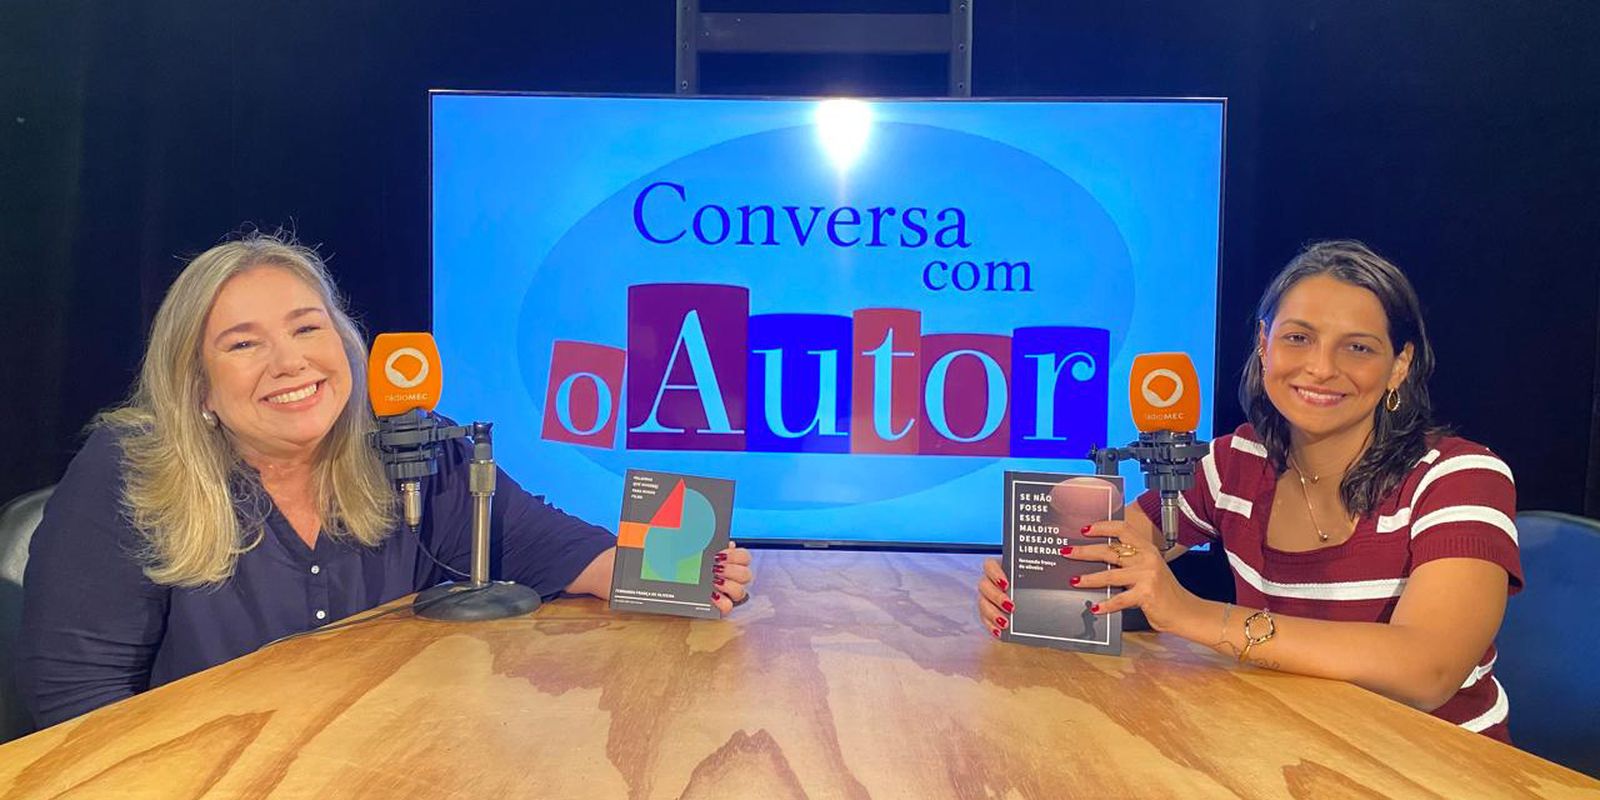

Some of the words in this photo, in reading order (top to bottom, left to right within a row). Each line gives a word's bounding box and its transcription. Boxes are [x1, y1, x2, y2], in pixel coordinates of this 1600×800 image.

[633, 181, 972, 249] Conversa
[922, 260, 1033, 292] com
[555, 372, 612, 436] o
[630, 309, 1096, 443] Autor
[1020, 493, 1031, 501] SE
[1033, 493, 1052, 502] NÃO
[1019, 503, 1048, 512] FOSSE
[1019, 514, 1041, 522] ESSE
[1019, 524, 1060, 535] MALDITO
[1019, 534, 1054, 545] DESEJO
[1056, 538, 1068, 546] DE
